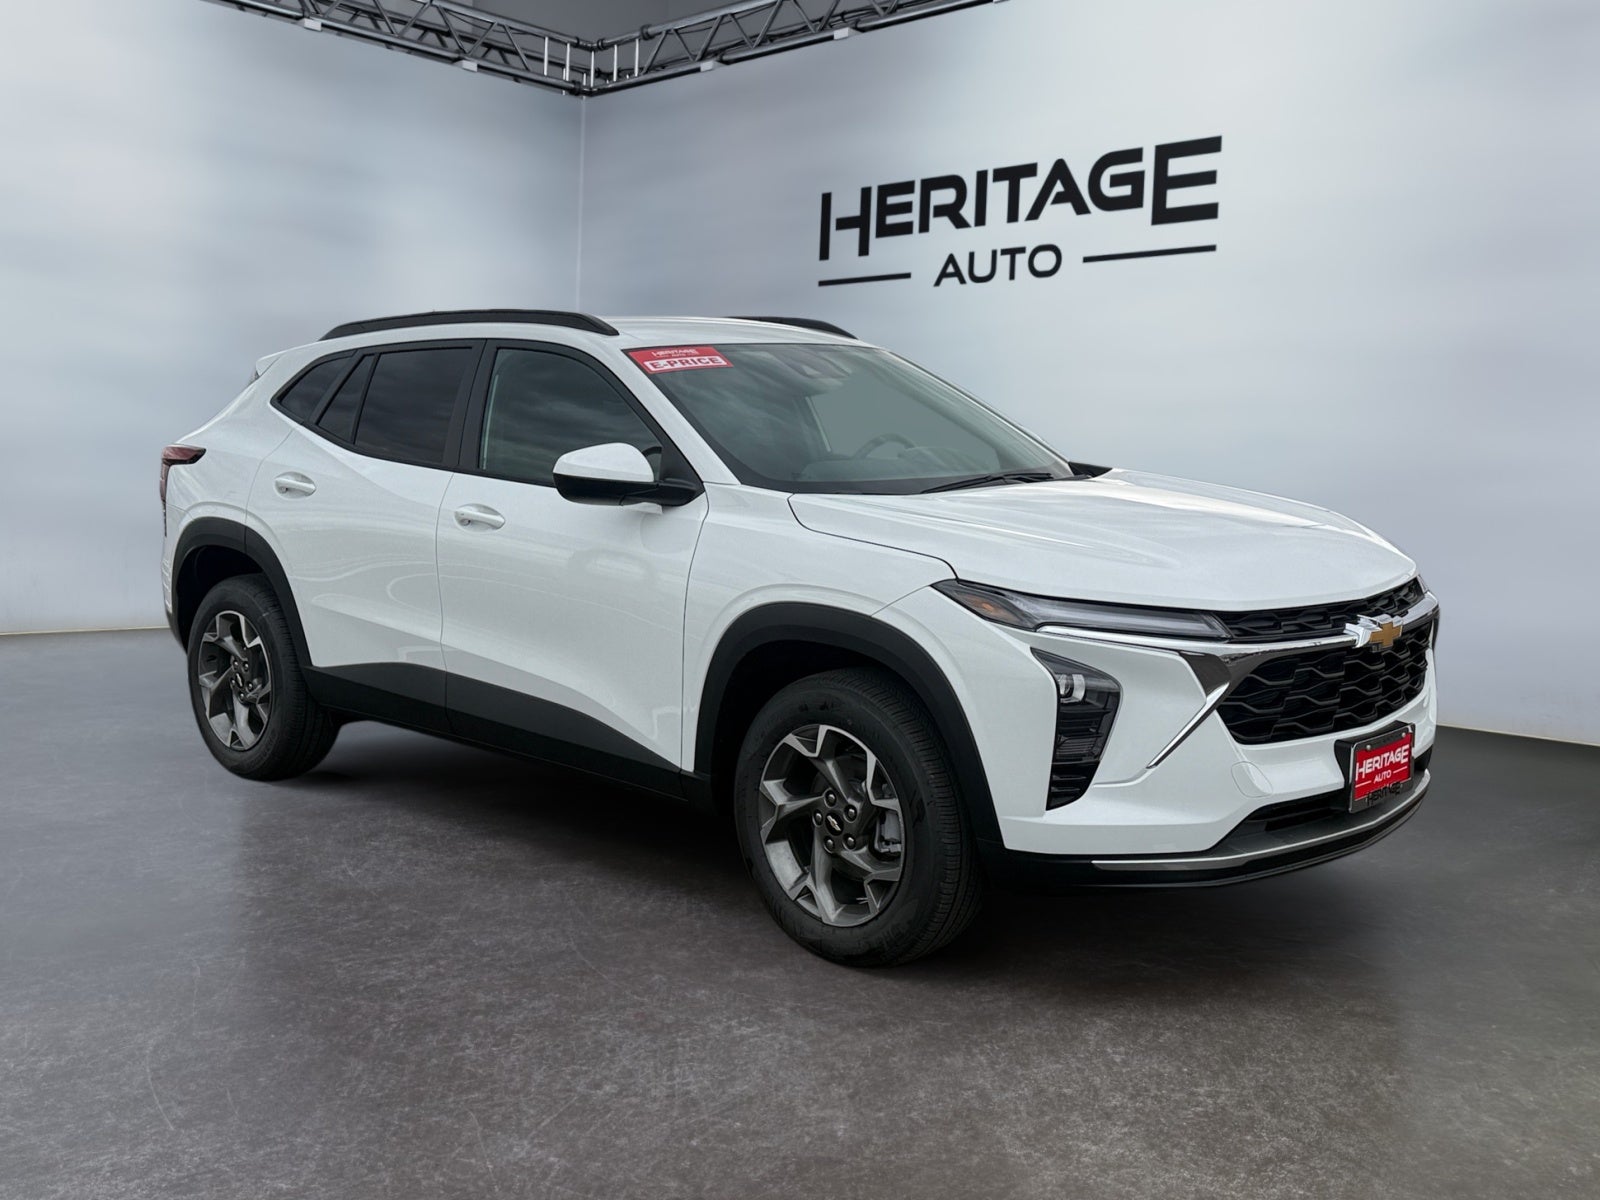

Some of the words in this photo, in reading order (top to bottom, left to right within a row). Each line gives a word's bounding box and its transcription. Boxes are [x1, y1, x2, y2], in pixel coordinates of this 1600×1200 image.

[819, 135, 1222, 261] HERITAGE
[933, 243, 1062, 287] AUTO
[649, 357, 721, 369] E-PRICE
[1355, 744, 1410, 782] HERITAGE
[1373, 769, 1392, 784] AUTO
